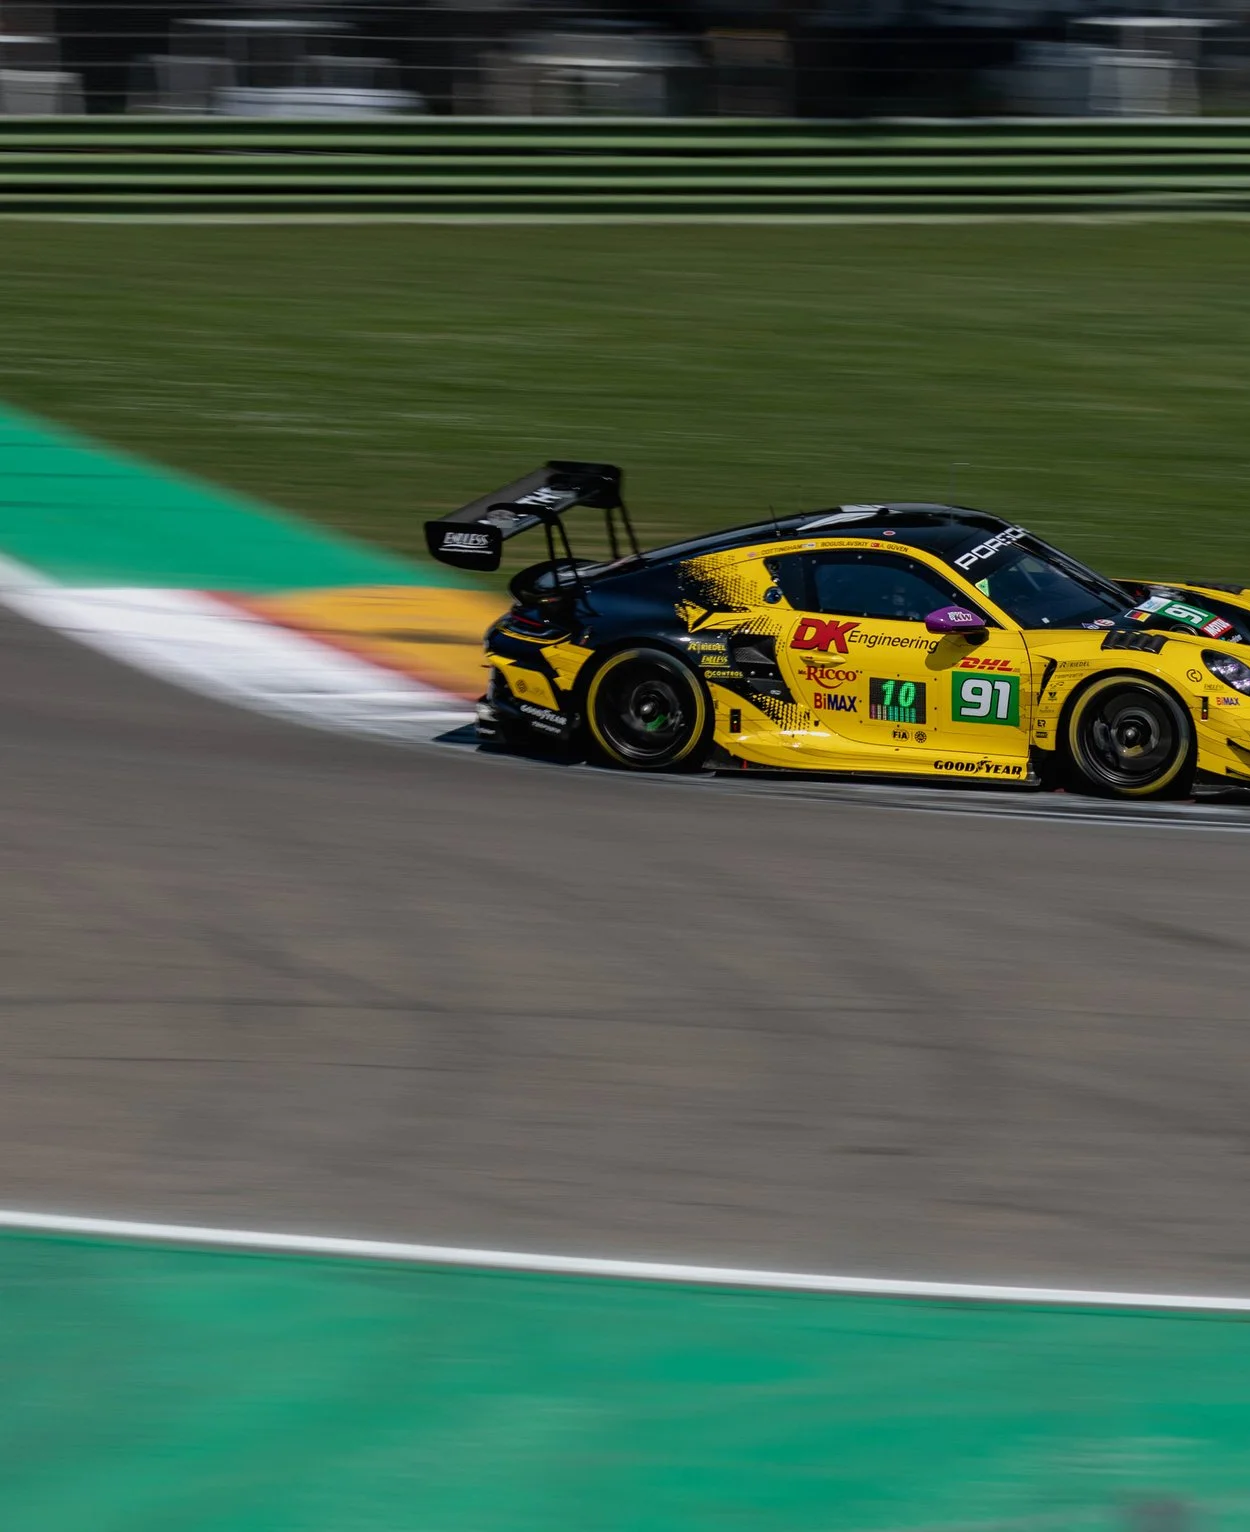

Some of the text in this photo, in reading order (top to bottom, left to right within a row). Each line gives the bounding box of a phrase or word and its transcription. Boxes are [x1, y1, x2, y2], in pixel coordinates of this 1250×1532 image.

[442, 532, 489, 547] ENDLESS
[954, 612, 972, 622] KW
[1164, 604, 1208, 624] 91
[790, 618, 940, 654] DK Engineering
[1204, 617, 1233, 637] MOTUL
[701, 643, 726, 651] RIEDEL
[960, 657, 1013, 672] DHL
[814, 693, 857, 712] BiMAX
[882, 680, 916, 708] 10
[960, 678, 1011, 720] 91
[892, 730, 908, 740] FIA
[934, 760, 1022, 778] GOODYEAR
